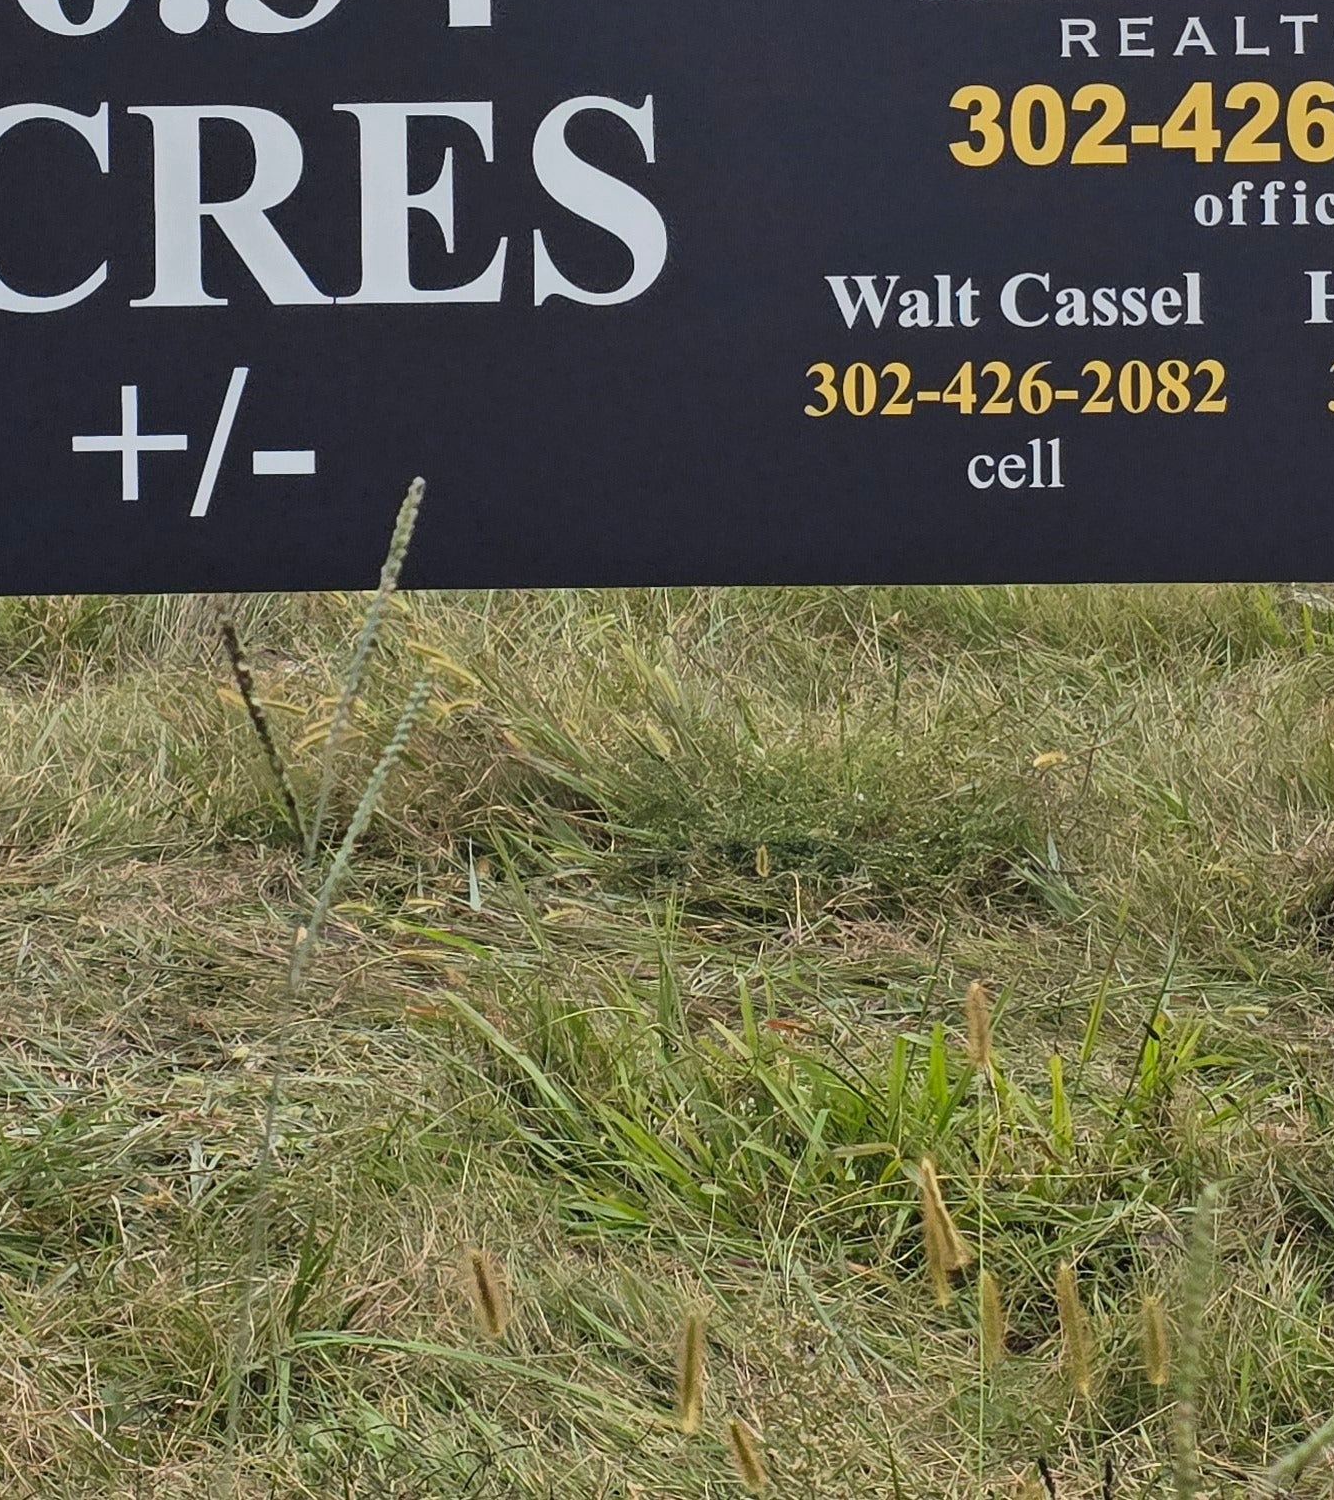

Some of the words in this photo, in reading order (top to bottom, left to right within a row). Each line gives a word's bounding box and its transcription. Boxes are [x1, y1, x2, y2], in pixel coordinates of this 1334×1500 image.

[823, 274, 981, 330] Walt
[999, 272, 1205, 328] Cassel
[803, 359, 1228, 417] 302-426-2082
[72, 367, 316, 517] +/-
[967, 437, 1066, 489] cell
